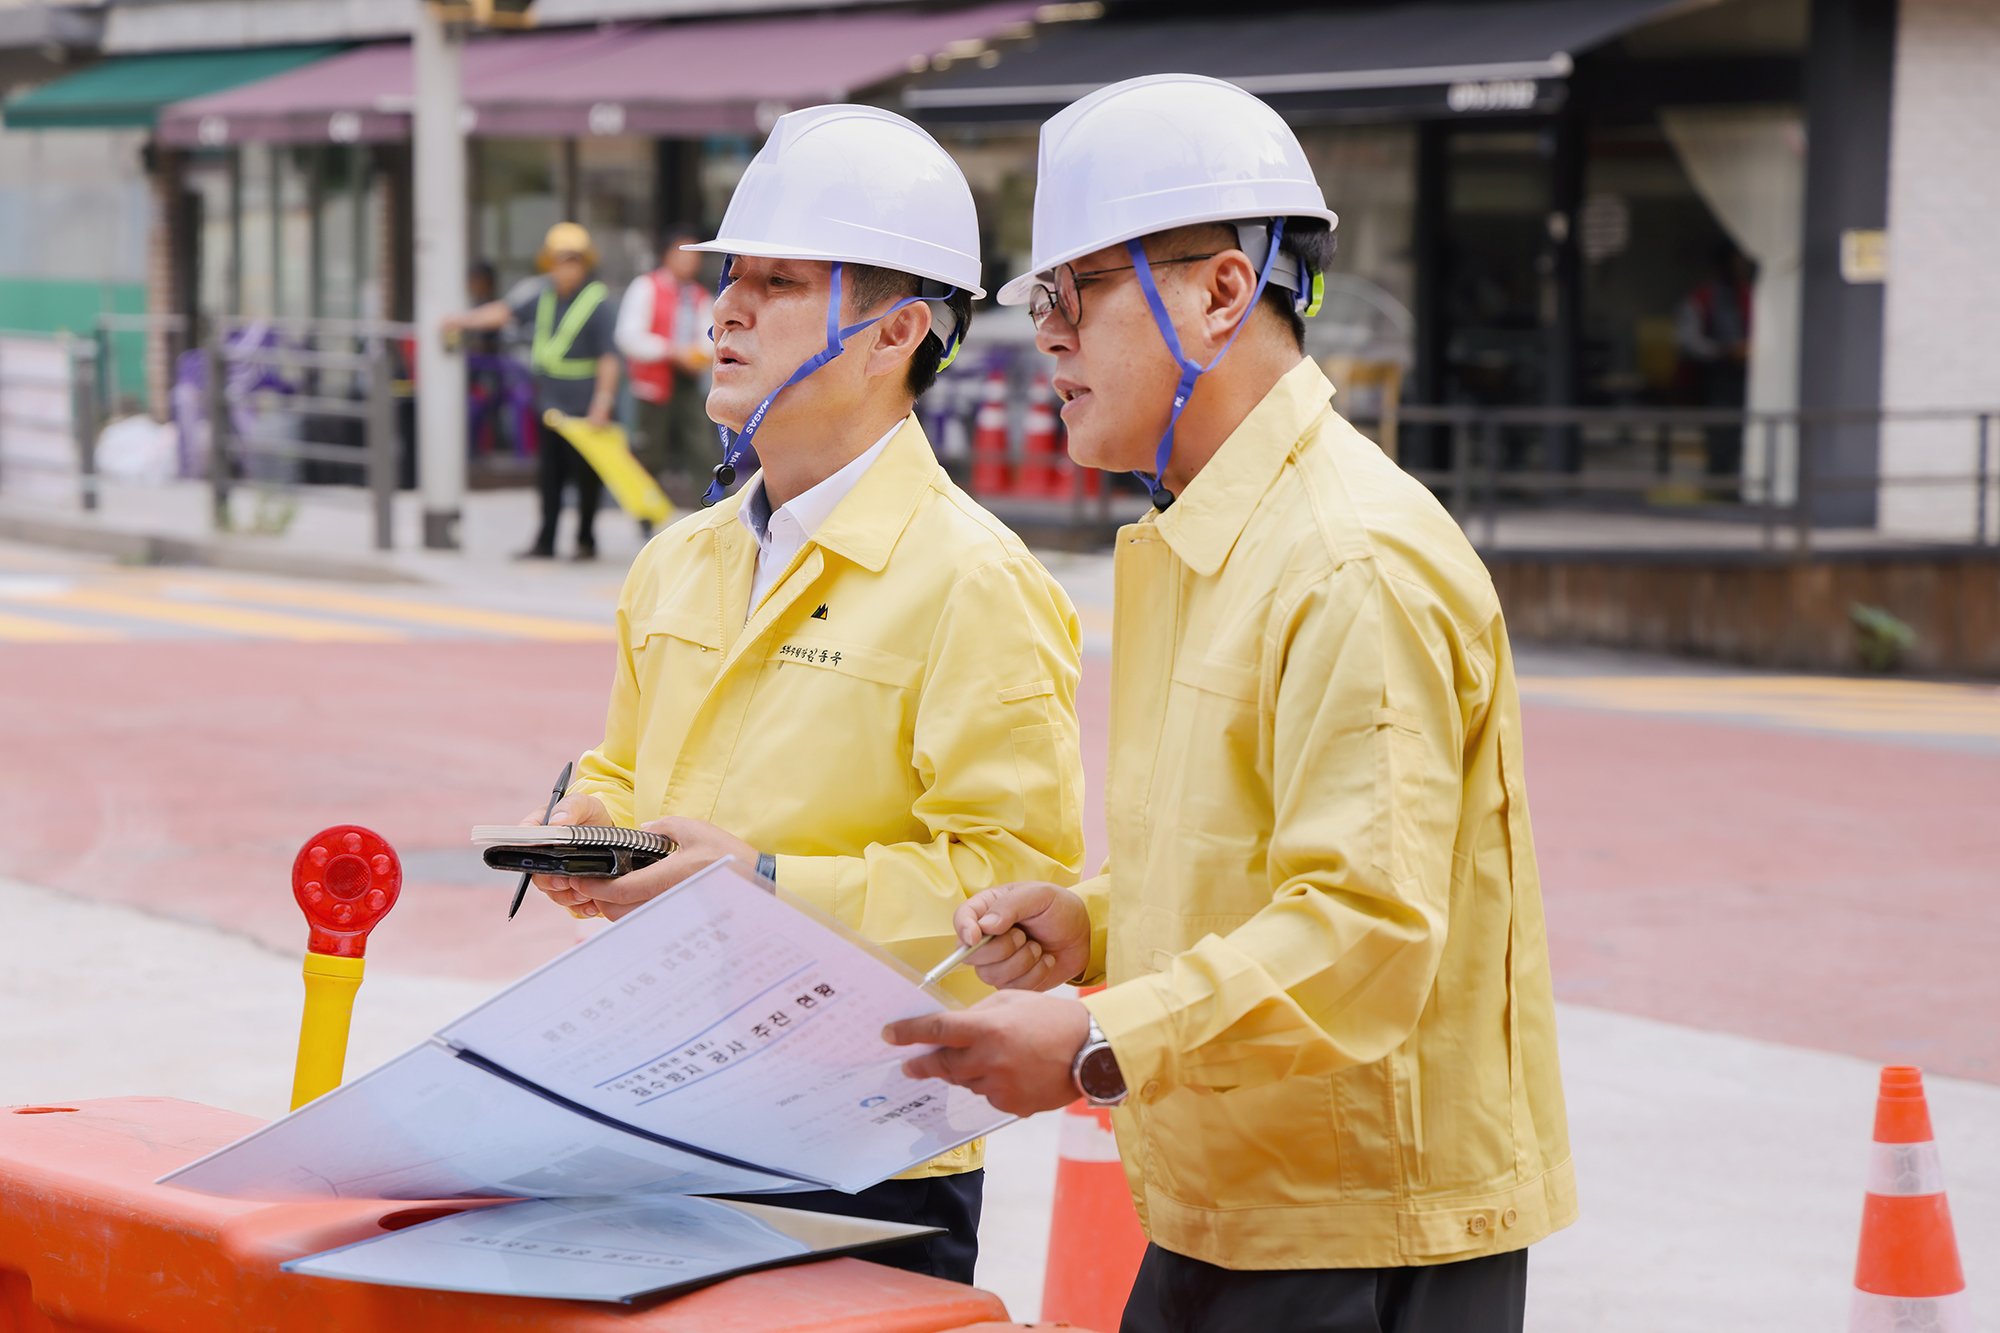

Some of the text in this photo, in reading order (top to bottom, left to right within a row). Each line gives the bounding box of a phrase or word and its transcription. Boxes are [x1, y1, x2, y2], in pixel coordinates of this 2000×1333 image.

[746, 400, 770, 435] MAGAS
[631, 983, 835, 1097] 침수방지 공사 추진 현황
